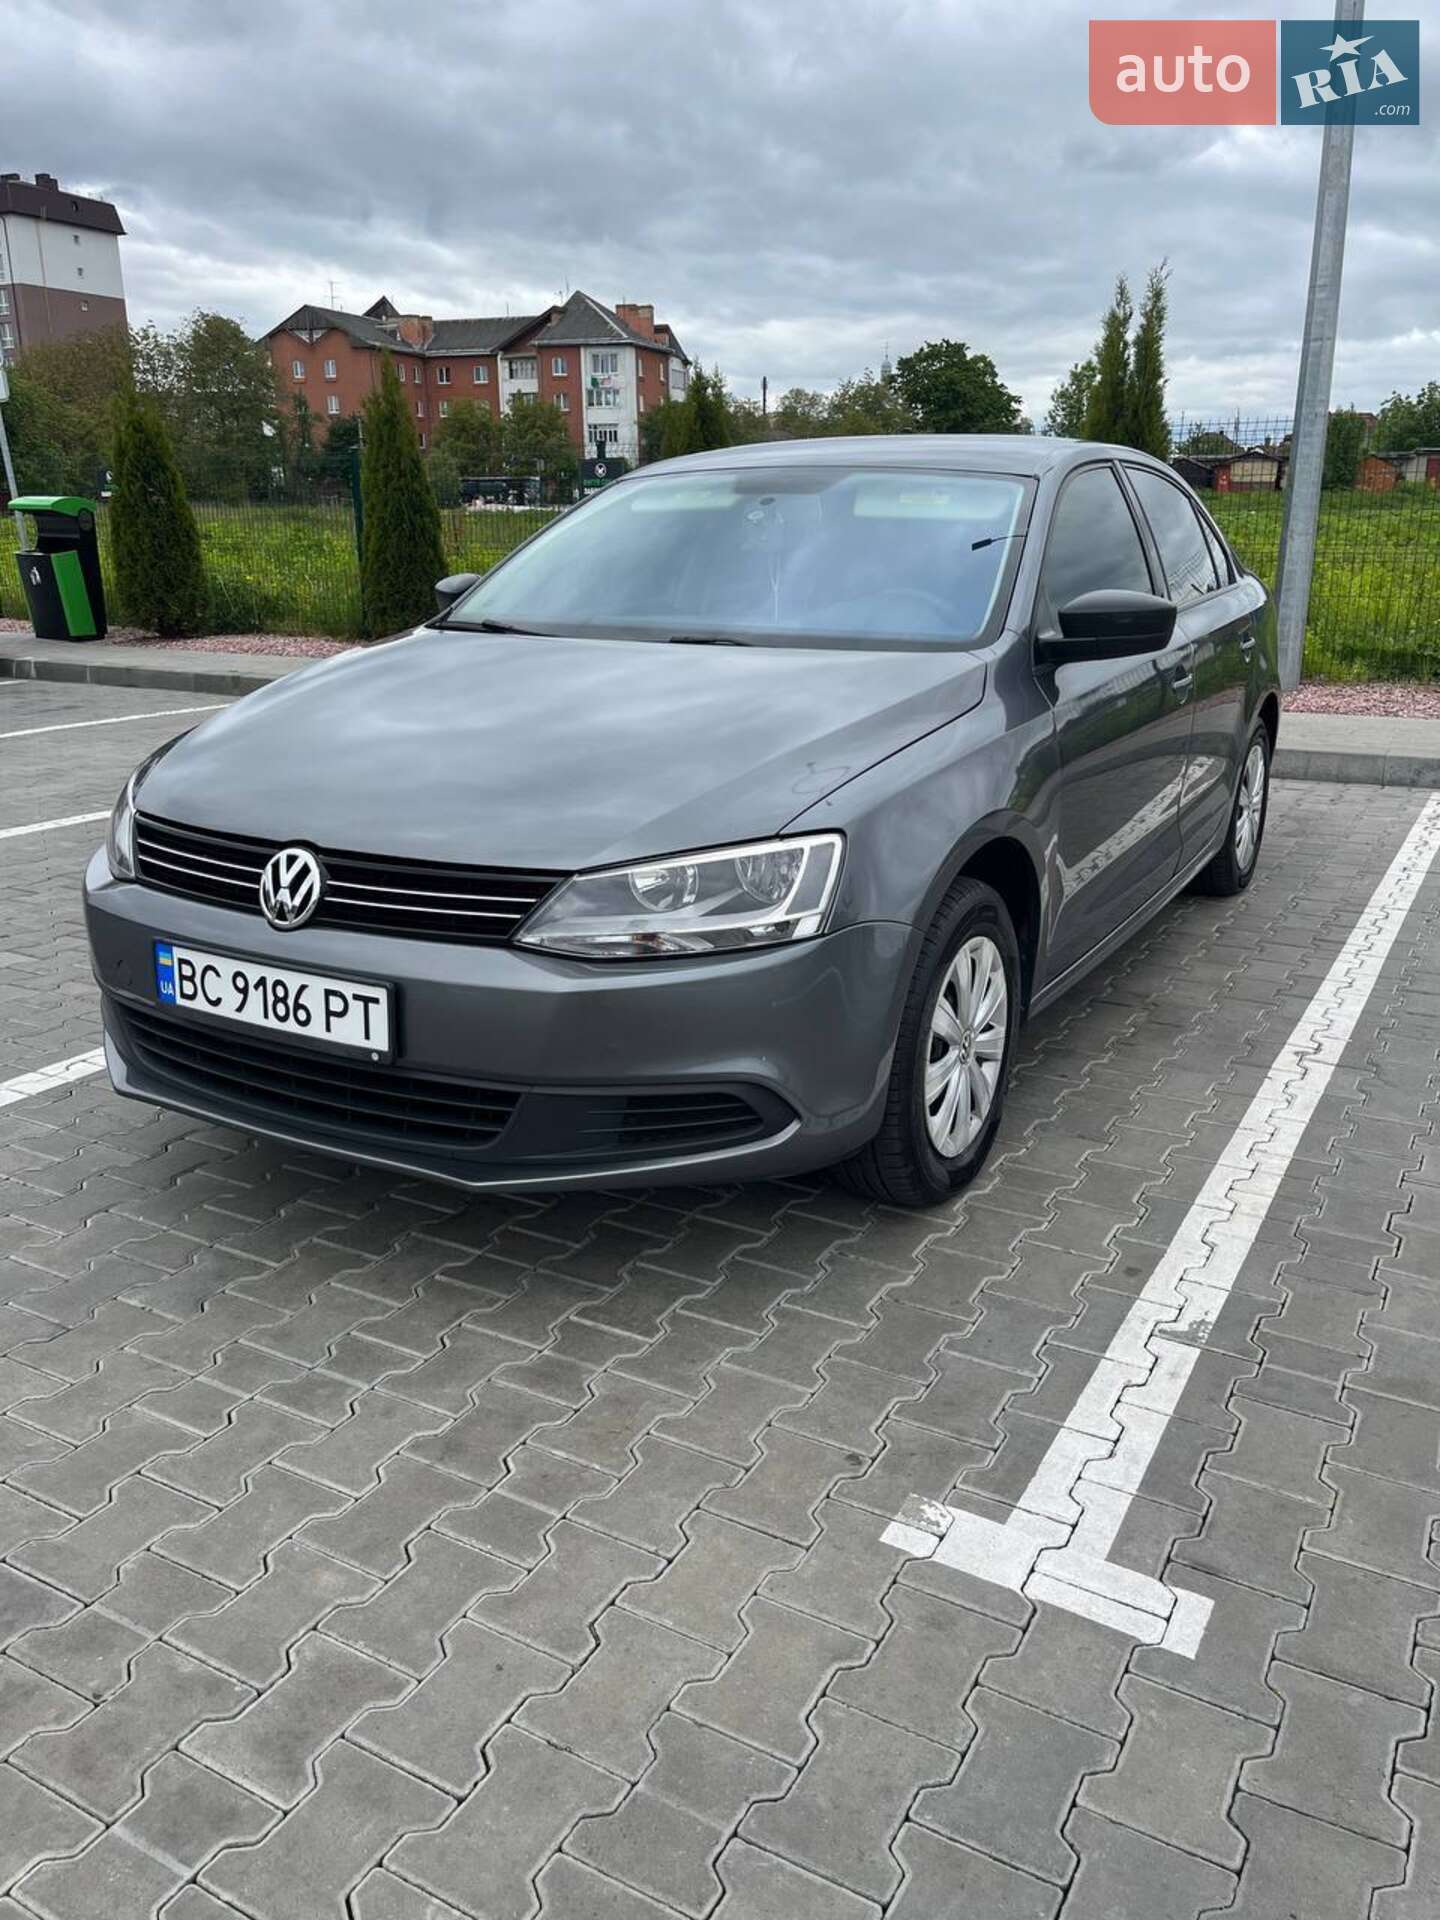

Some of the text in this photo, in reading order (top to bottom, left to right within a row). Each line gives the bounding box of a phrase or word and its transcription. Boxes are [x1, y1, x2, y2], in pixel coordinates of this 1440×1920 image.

[260, 848, 320, 926] VW
[160, 980, 175, 996] UA
[177, 957, 380, 1041] BC 9186 PT
